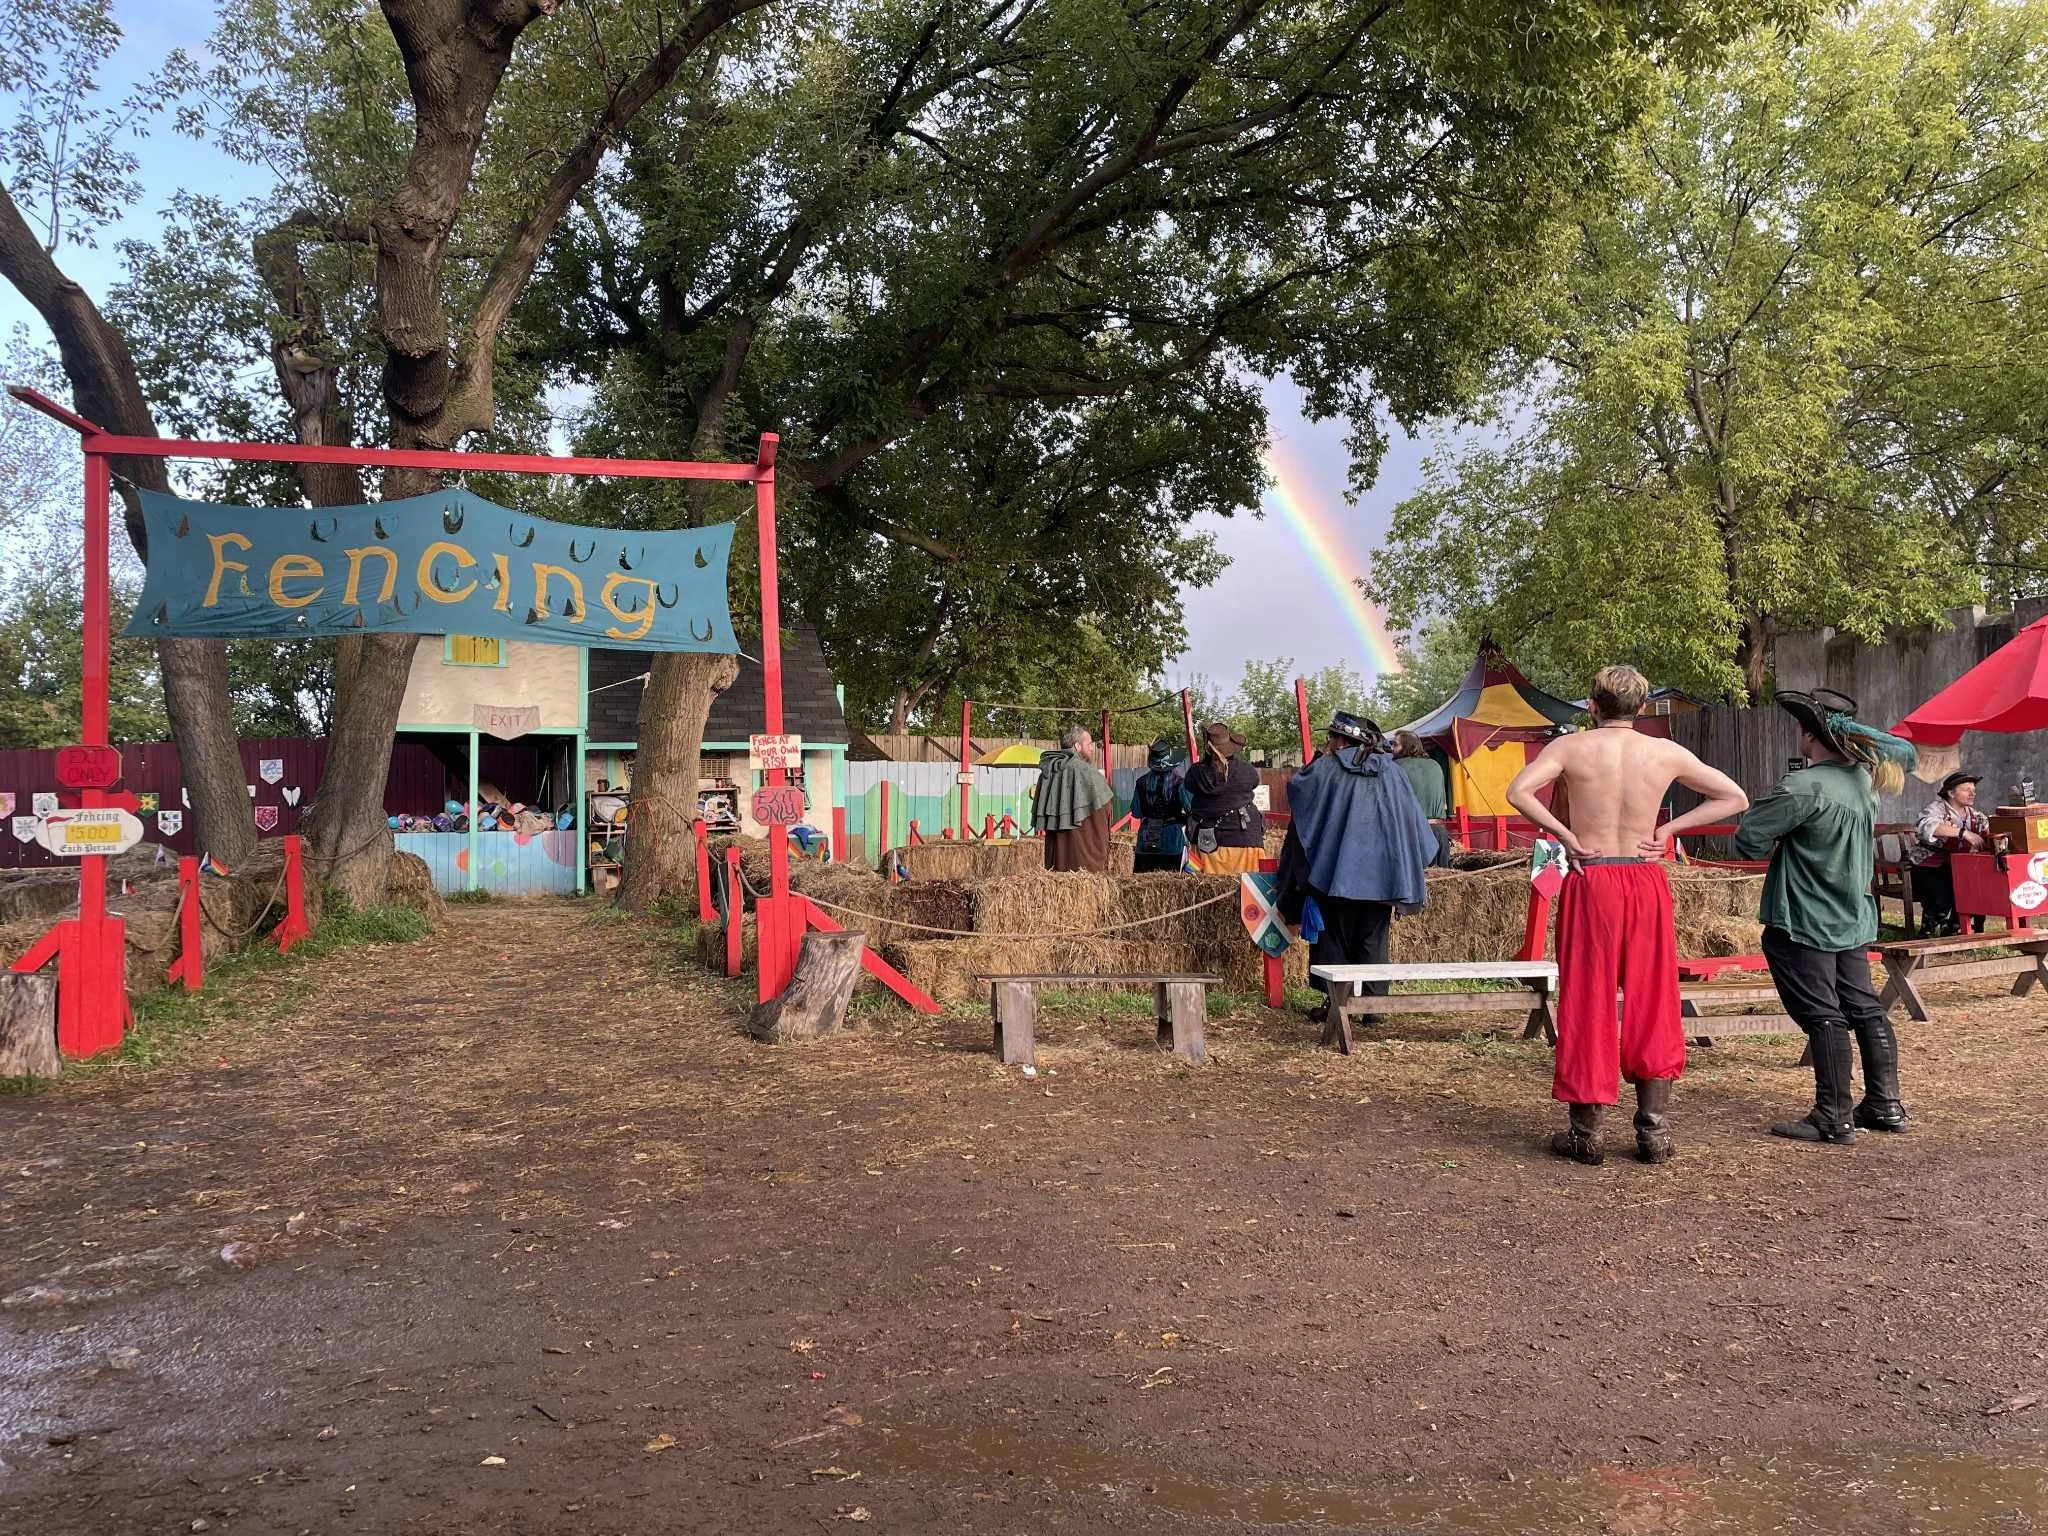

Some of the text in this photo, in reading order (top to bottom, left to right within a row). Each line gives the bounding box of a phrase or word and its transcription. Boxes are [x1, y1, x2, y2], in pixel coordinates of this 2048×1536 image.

[490, 714, 521, 728] EXIT
[752, 735, 790, 746] FENCE AT
[68, 749, 106, 763] EXIT
[753, 745, 799, 757] YOUR OWN
[67, 767, 110, 783] ONLY
[758, 789, 796, 804] EXIT
[74, 811, 120, 822] Fencing
[756, 803, 798, 825] ONLY
[1727, 1018, 1781, 1032] BOOTH
